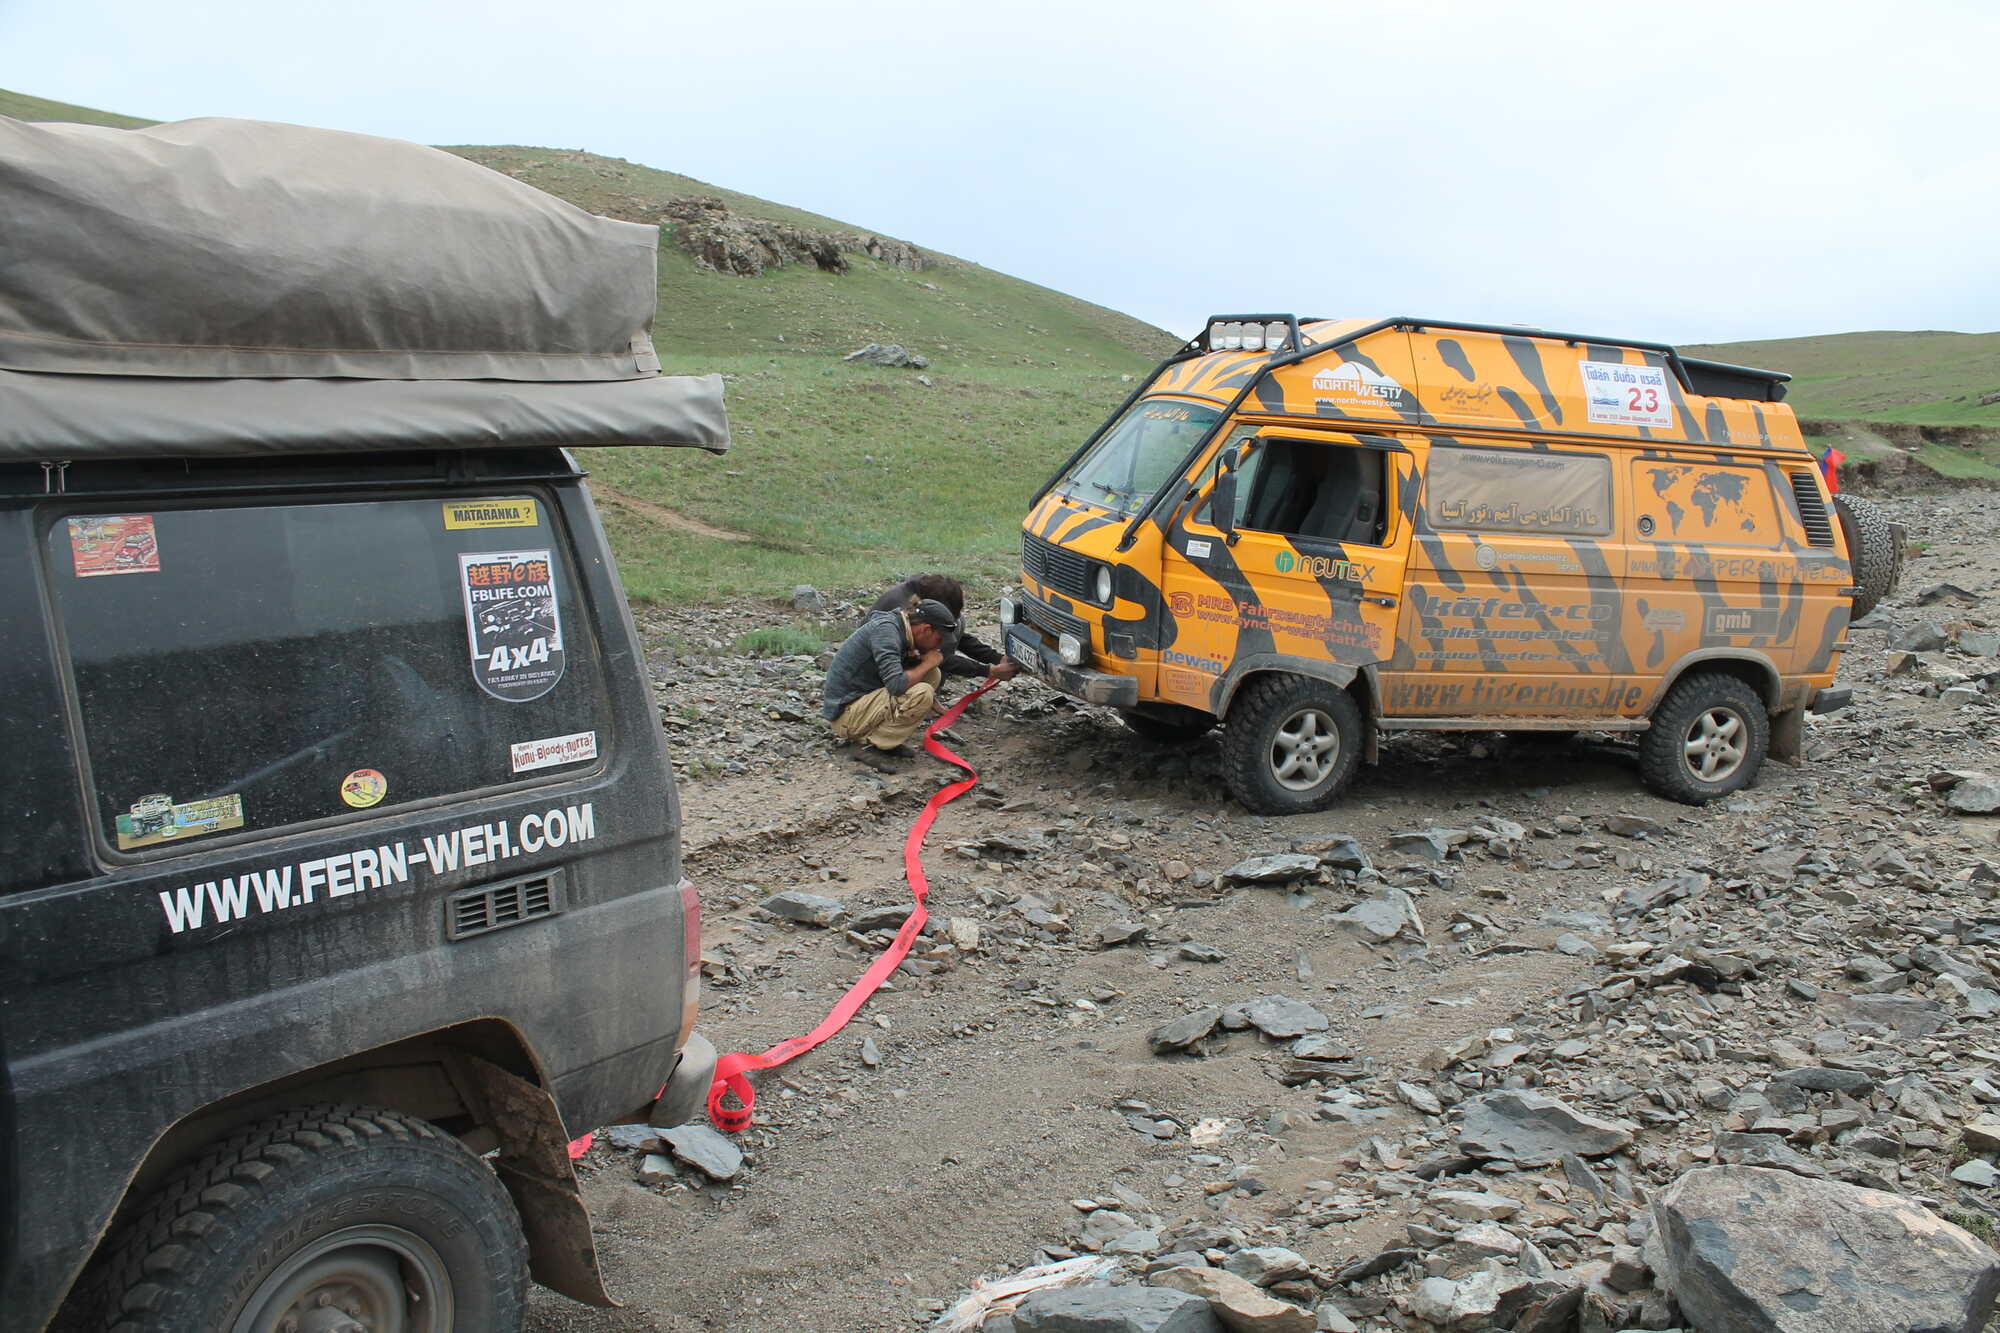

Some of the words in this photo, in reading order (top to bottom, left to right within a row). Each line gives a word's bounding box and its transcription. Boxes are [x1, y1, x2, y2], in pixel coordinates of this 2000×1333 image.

[1628, 387, 1659, 412] 23
[453, 507, 520, 522] MATARANKA
[471, 585, 550, 602] FBLIFE.COM
[1715, 611, 1751, 633] gmb
[488, 637, 550, 672] 4x4
[1163, 649, 1223, 674] pewag
[159, 802, 596, 934] WWW.FERN-WEH.COM
